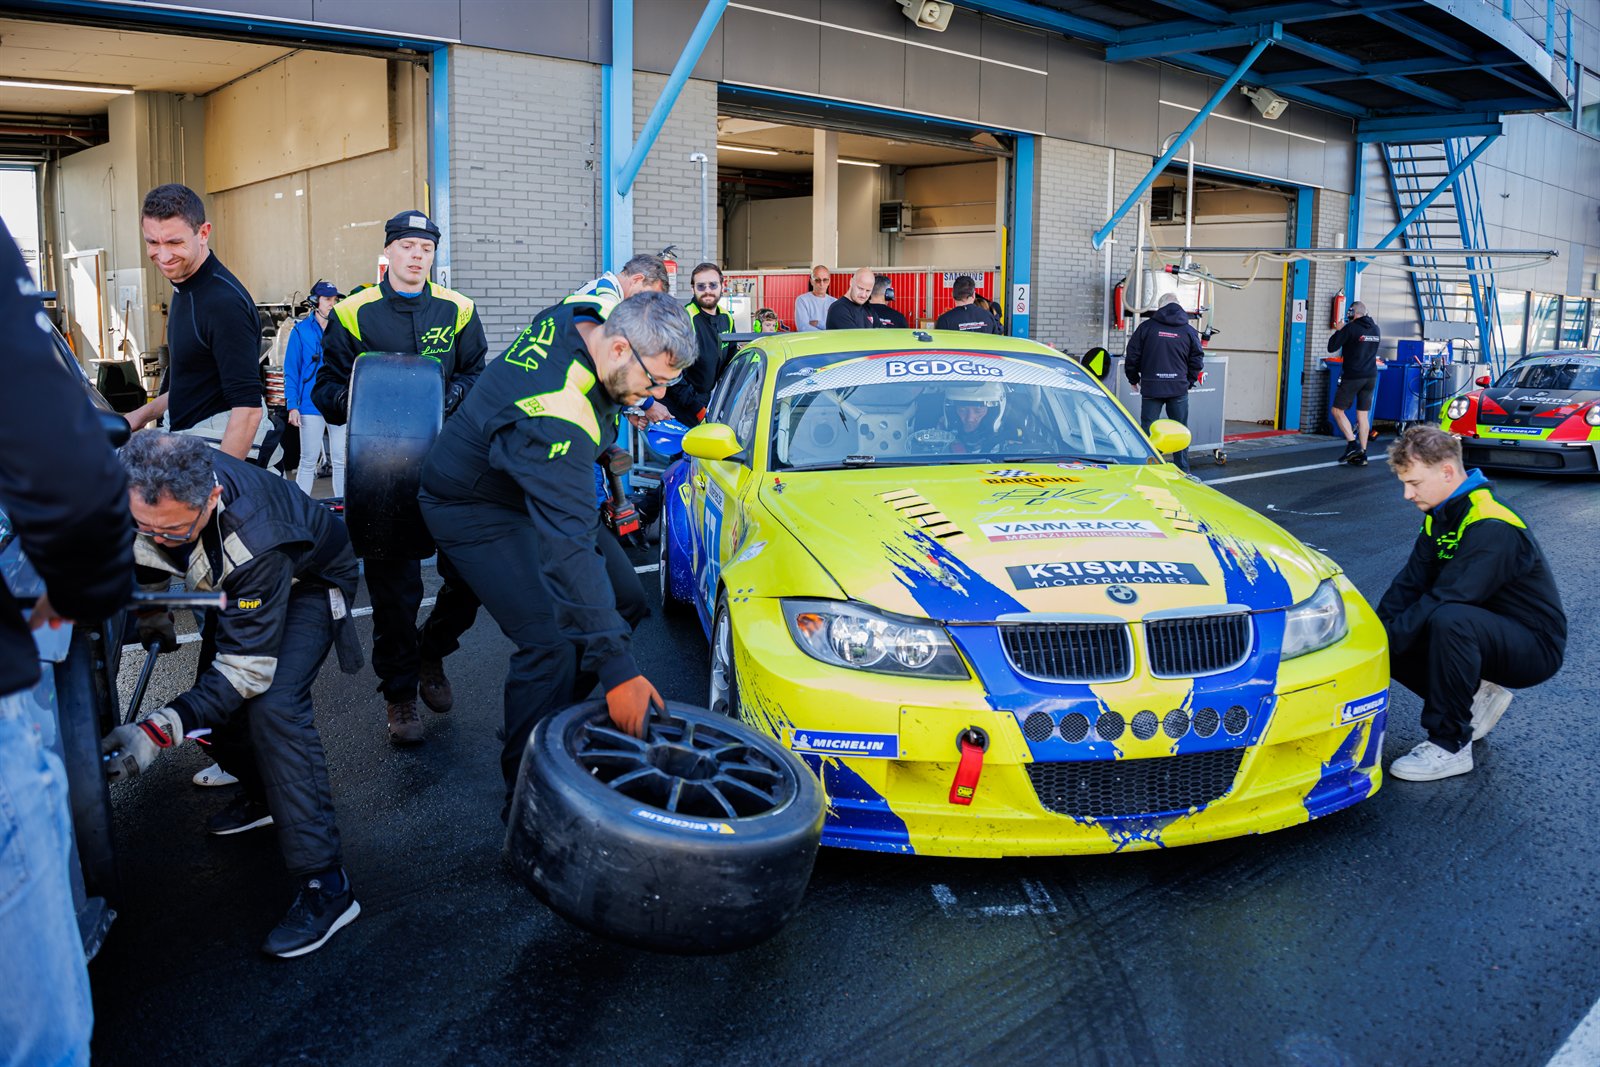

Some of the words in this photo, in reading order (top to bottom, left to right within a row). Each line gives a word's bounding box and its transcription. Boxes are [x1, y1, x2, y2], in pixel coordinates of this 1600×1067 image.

[440, 271, 447, 288] 3
[1018, 287, 1025, 300] 2
[1298, 302, 1302, 312] 1
[887, 360, 1003, 377] BGDC.be
[1516, 395, 1573, 403] Averna
[986, 476, 1081, 485] BARDAHL
[994, 520, 1147, 534] VAMM-RACK
[1005, 531, 1152, 541] MAGAZIJNINRICHTING
[1025, 561, 1185, 579] KRISMAR
[1034, 576, 1191, 588] MOTORHOMES
[239, 600, 261, 609] OMP
[1352, 697, 1385, 716] MICHELIN
[812, 738, 885, 751] MICHELIN
[637, 809, 708, 831] MICHELIN
